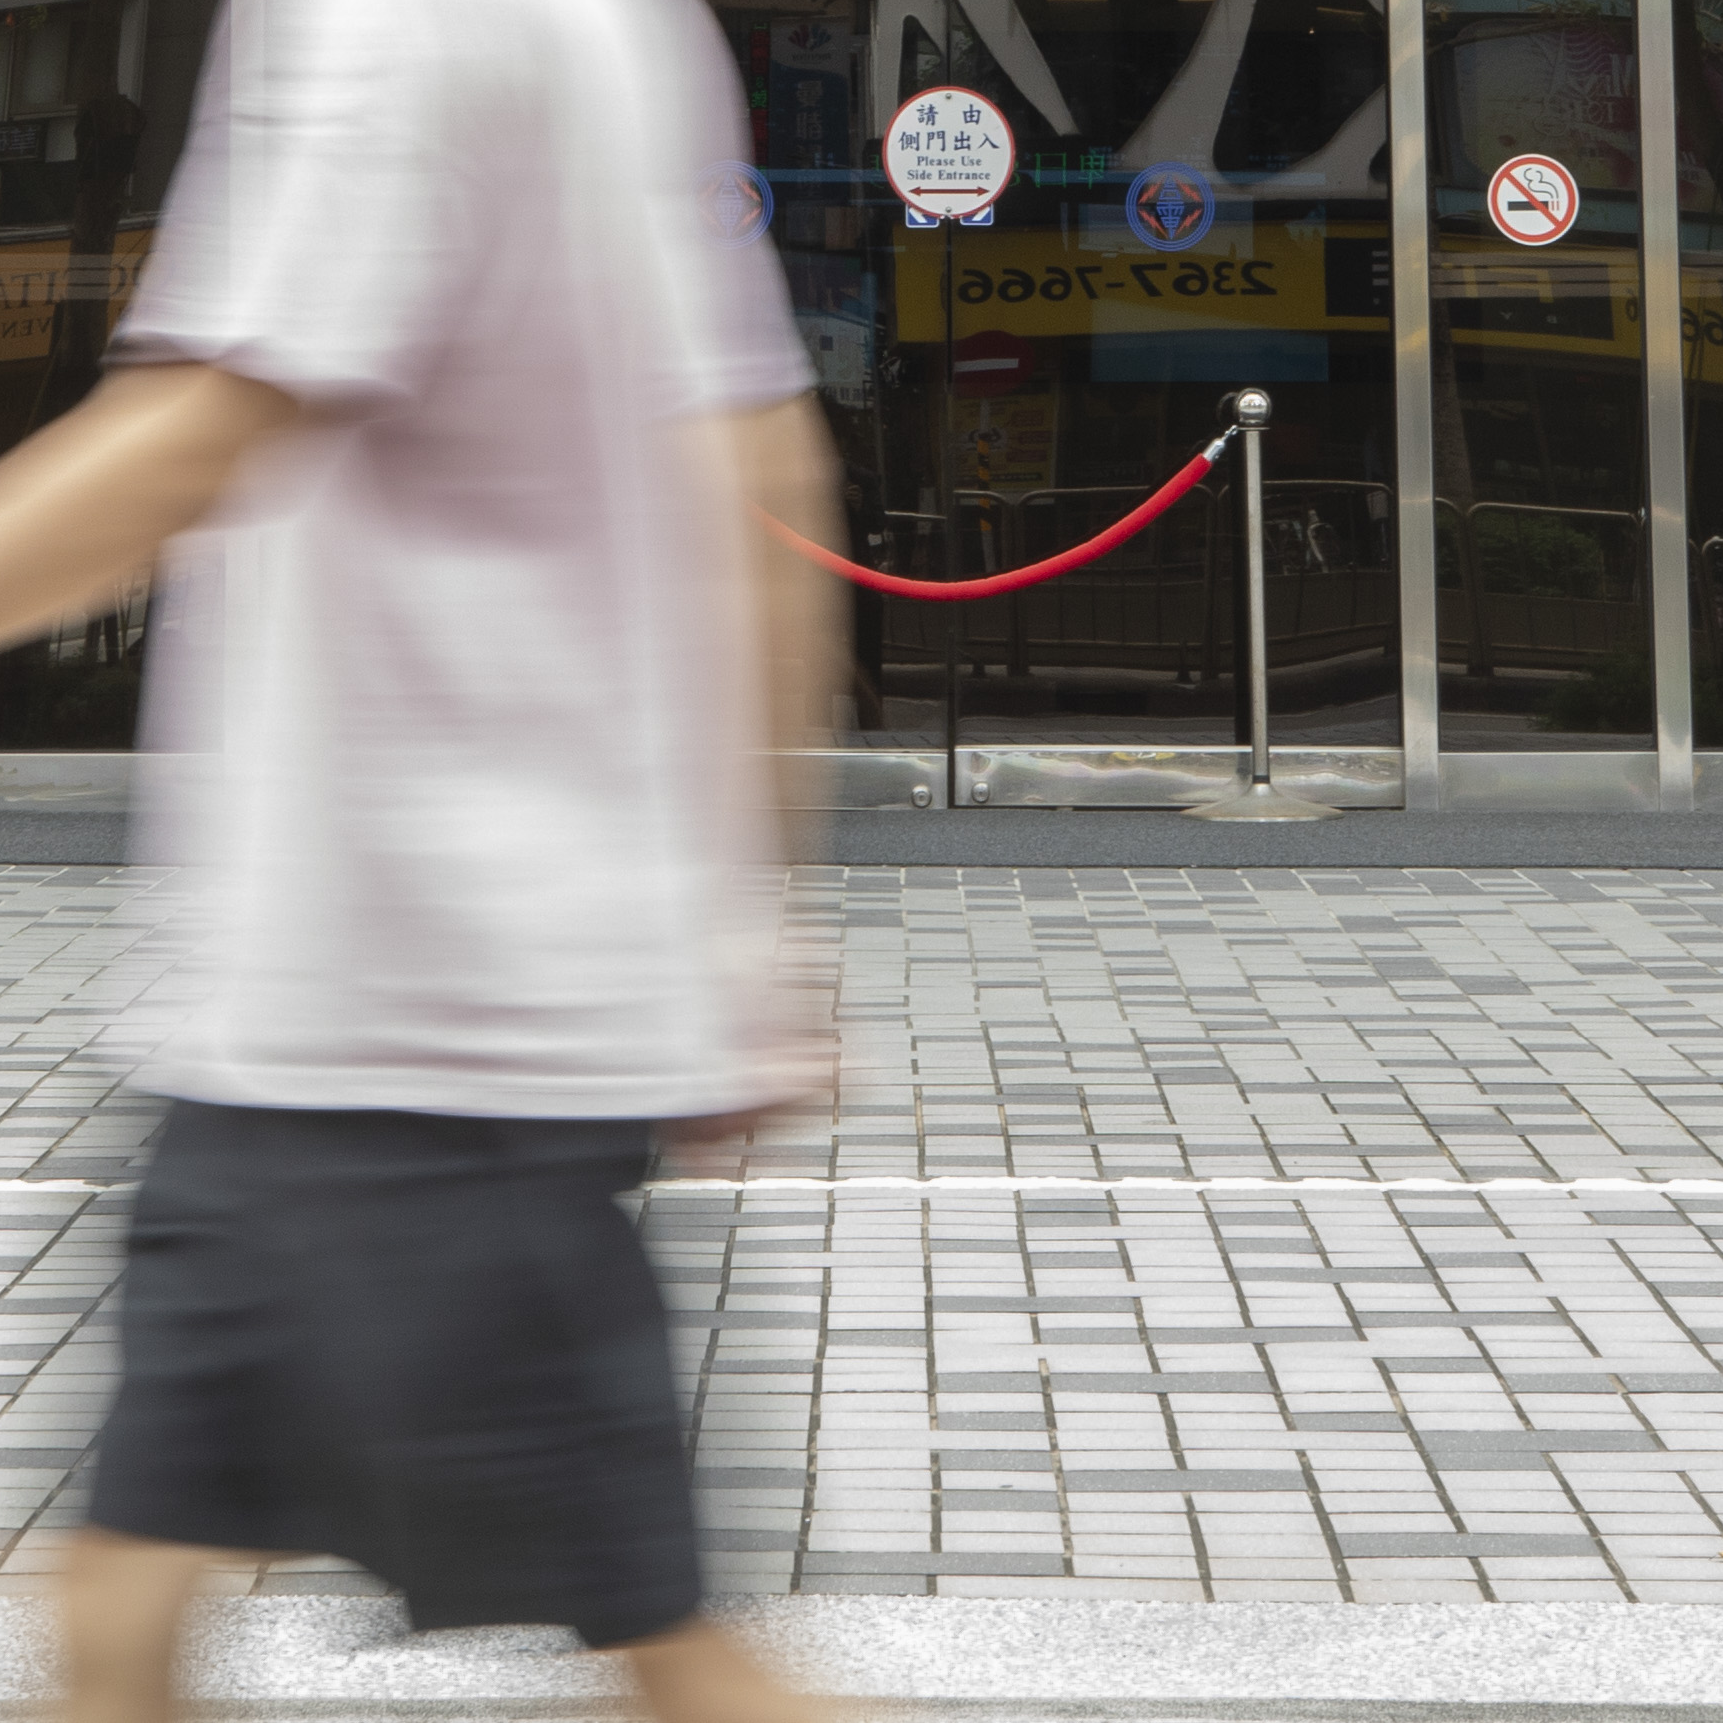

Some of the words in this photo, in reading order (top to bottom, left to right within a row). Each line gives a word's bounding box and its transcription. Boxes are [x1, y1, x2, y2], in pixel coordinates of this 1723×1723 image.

[898, 131, 1000, 152] 側門出入
[916, 155, 955, 166] Please
[961, 155, 982, 166] Use
[907, 169, 933, 181] Side
[938, 169, 991, 181] Entrance
